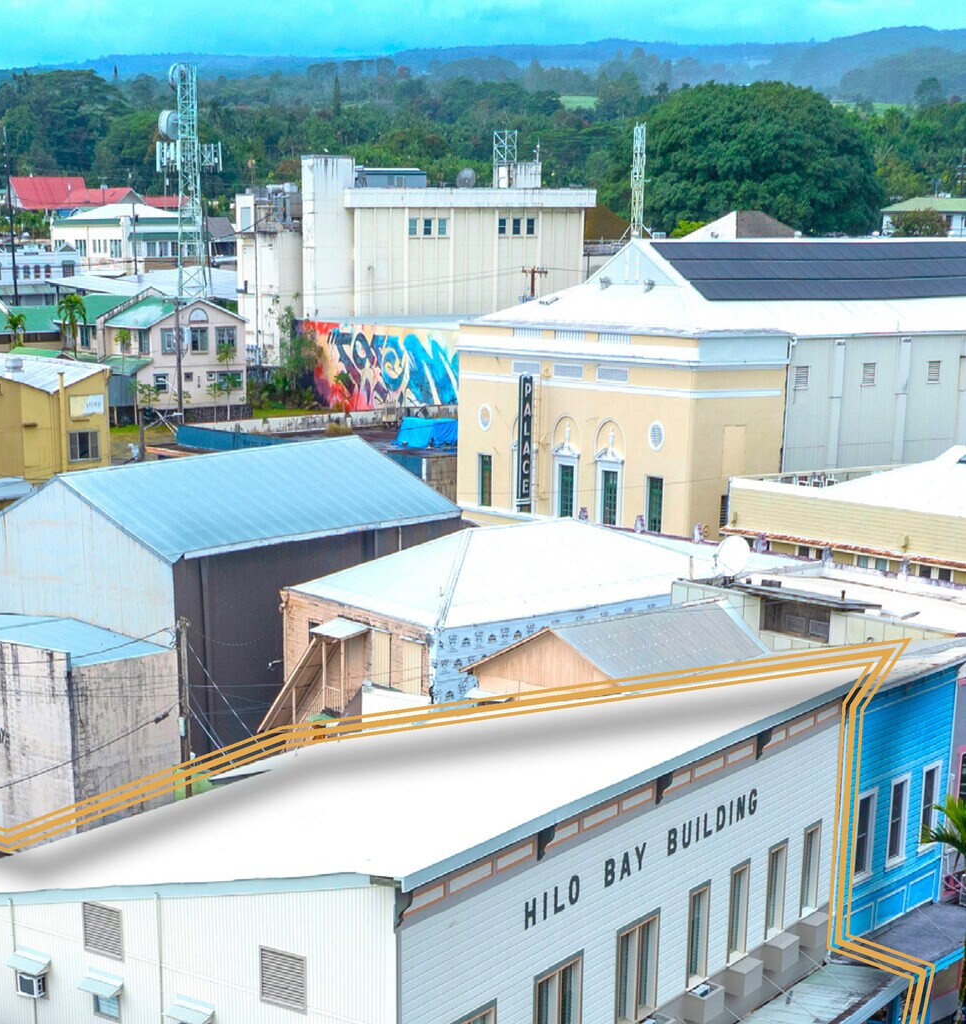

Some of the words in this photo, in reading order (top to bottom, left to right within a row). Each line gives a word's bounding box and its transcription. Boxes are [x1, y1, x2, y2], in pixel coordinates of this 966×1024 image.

[522, 382, 532, 494] PALACE
[524, 874, 580, 930] HILO
[604, 842, 647, 888] BAY
[667, 788, 758, 857] BUILDING
